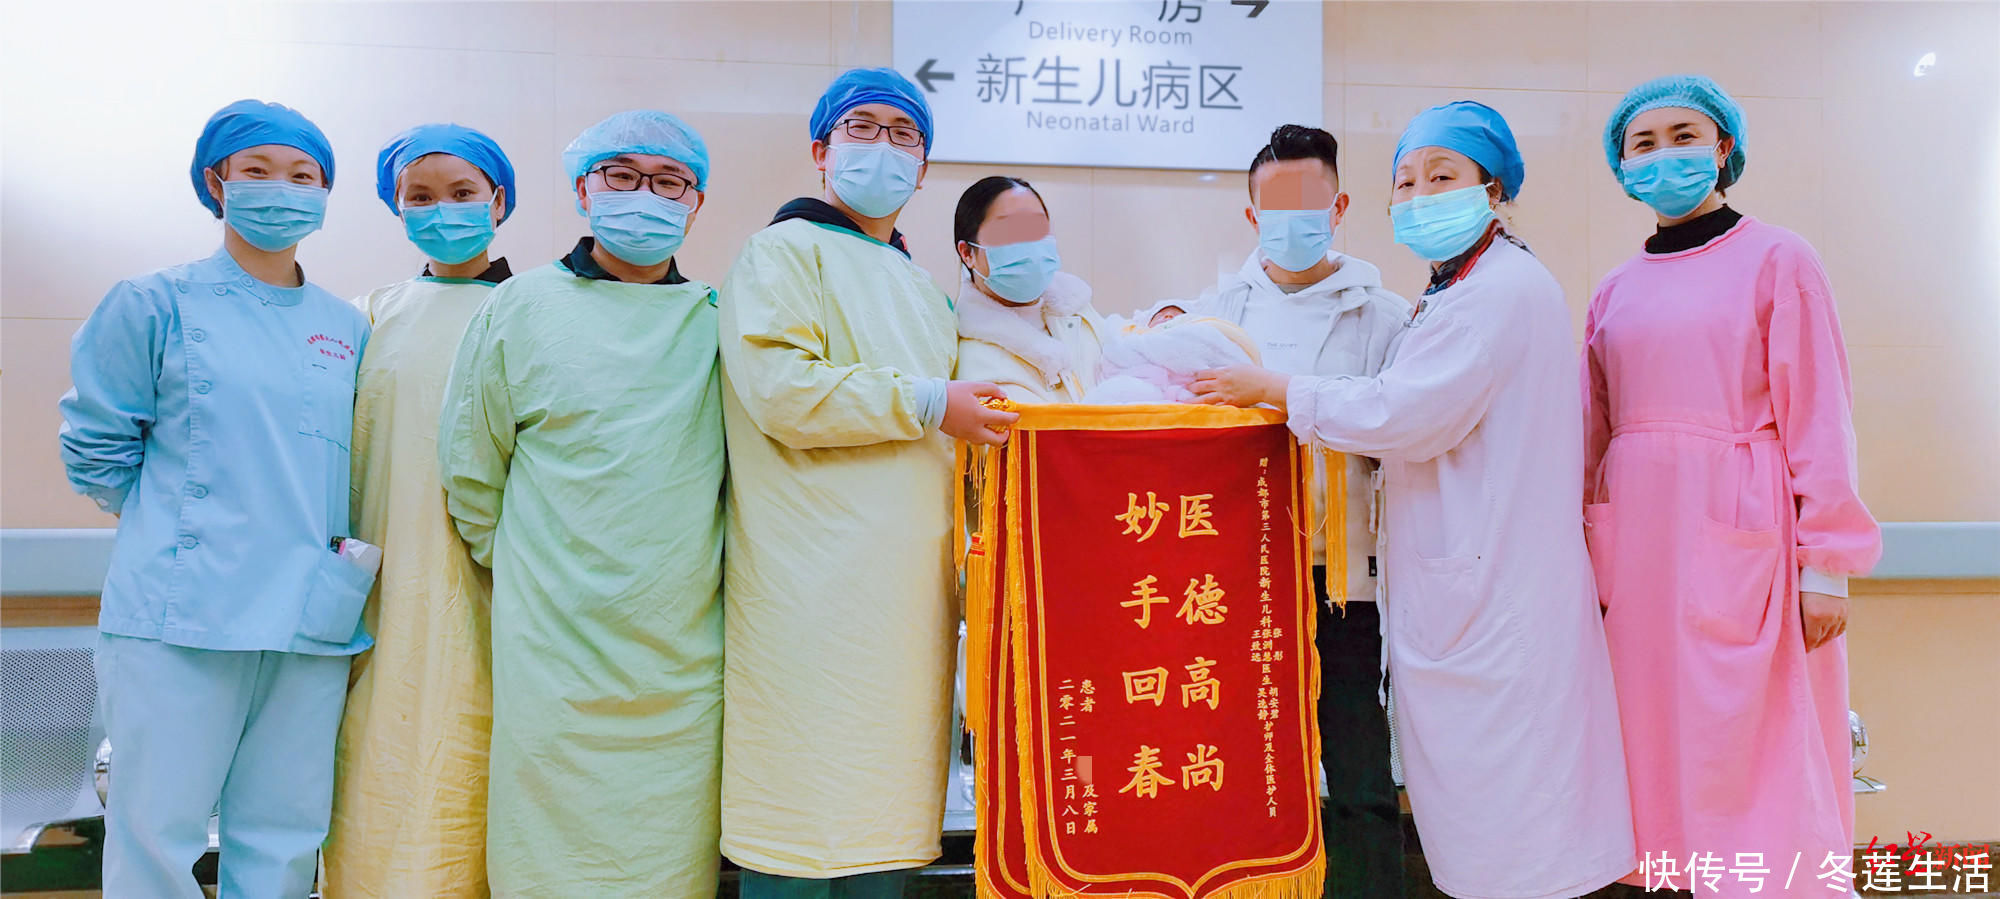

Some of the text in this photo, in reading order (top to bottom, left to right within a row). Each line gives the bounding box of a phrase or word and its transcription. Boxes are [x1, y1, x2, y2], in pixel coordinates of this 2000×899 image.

[1029, 20, 1193, 47] Delivery Room
[976, 53, 1243, 110] 新生儿病区
[1027, 110, 1195, 134] Neonatal Ward
[1114, 491, 1176, 799] 妙手回春
[1175, 493, 1229, 792] 医德高尚
[1079, 679, 1097, 714] 患者
[1058, 678, 1080, 836] 二零二一年三月八日
[1082, 784, 1099, 835] 及家属
